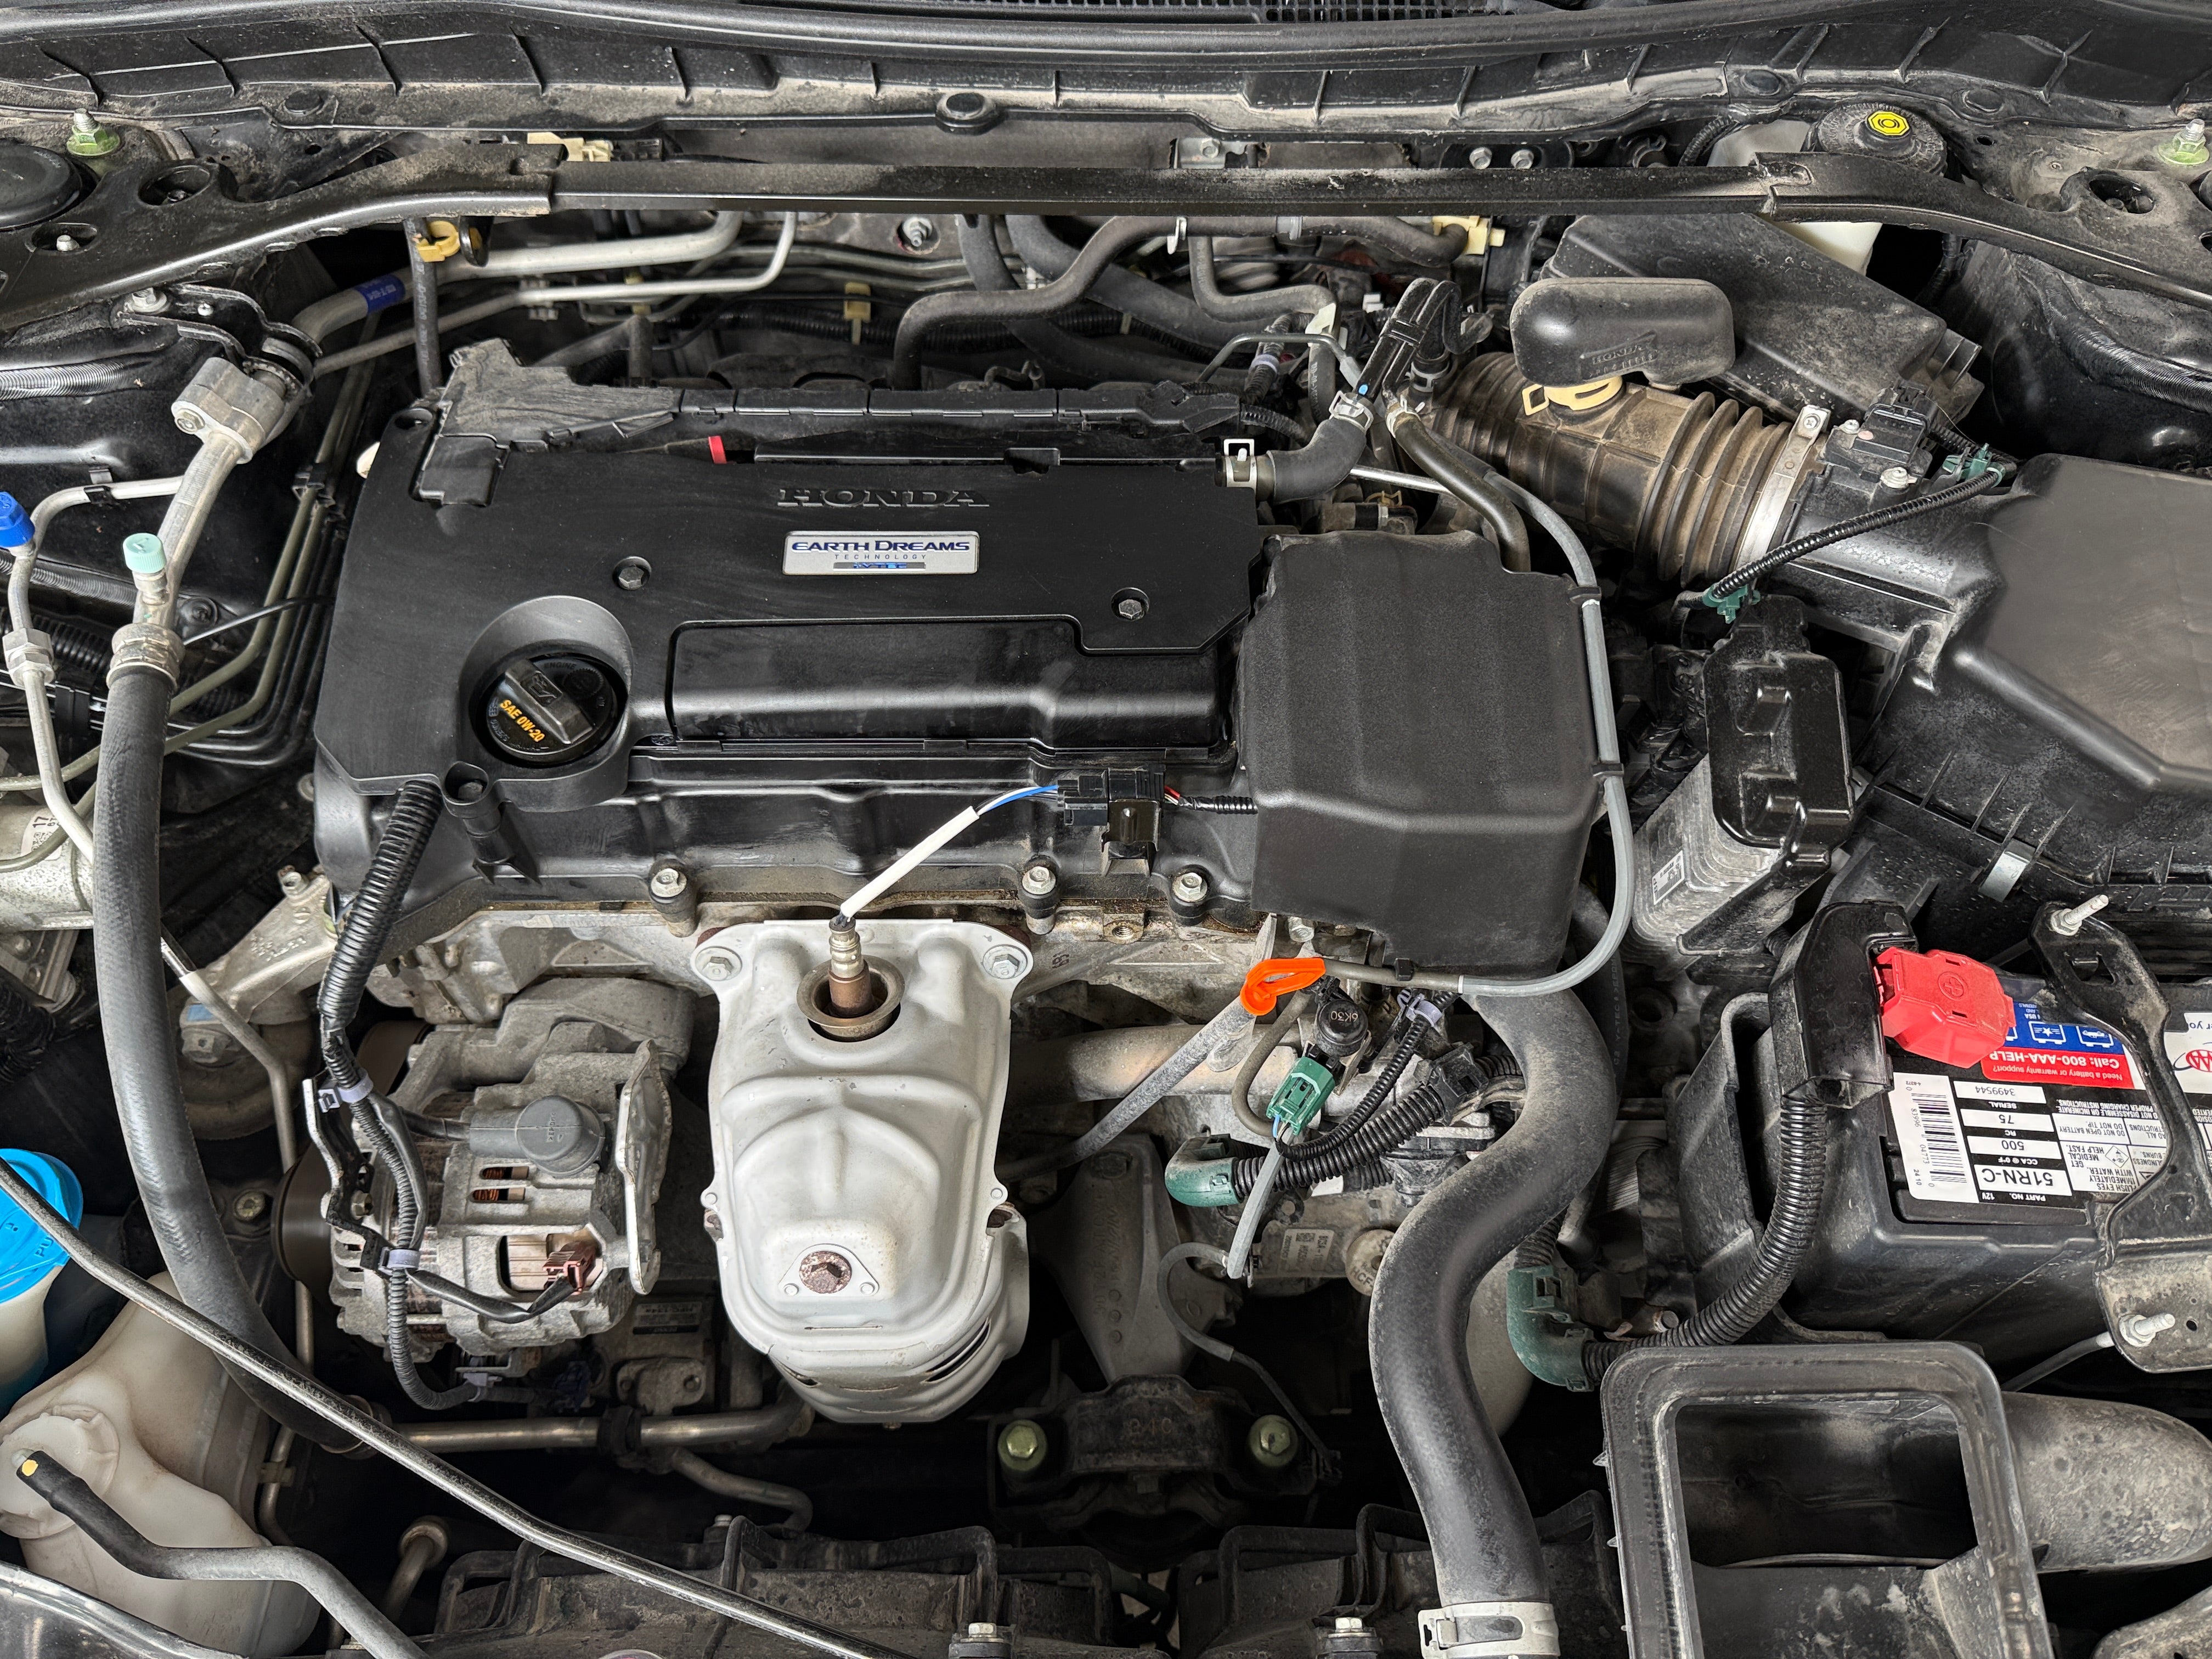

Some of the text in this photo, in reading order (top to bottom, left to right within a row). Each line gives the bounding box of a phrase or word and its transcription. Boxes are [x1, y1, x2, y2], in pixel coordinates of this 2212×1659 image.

[777, 489, 989, 507] HONDA
[792, 540, 970, 554] EARTH DREAMS
[543, 662, 577, 670] ENGINE
[500, 699, 546, 742] SAE 0W-20
[1330, 1011, 1358, 1023] 6K30
[1989, 1051, 2120, 1069] Call: 800-AAA-HELP
[1993, 1065, 2024, 1073] support?
[2026, 1066, 2058, 1075] warranty
[2069, 1069, 2095, 1079] battery
[1975, 1084, 2016, 1096] 3499544
[2056, 1099, 2154, 1113] PROPER CHARGING INSTRUCTIONS.
[2101, 1109, 2140, 1118] DISASSEMBLE
[1999, 1114, 2015, 1124] 75
[2059, 1126, 2085, 1135] BATTERY
[1910, 1108, 1922, 1127] 83996
[1920, 1144, 1930, 1164] 04773
[2001, 1139, 2025, 1150] 500
[2087, 1146, 2105, 1154] HELP
[2140, 1151, 2163, 1159] BURNS.
[2068, 1152, 2100, 1161] MEDICAL
[2071, 1160, 2085, 1168] GET
[1914, 1169, 1921, 1177] 24
[2086, 1166, 2134, 1177] WITH WATER.
[1981, 1168, 2053, 1187] 51RN-C
[2089, 1175, 2136, 1186] IMMEDIATELY
[2097, 1183, 2114, 1192] EYES
[1982, 1192, 1995, 1200] 12V
